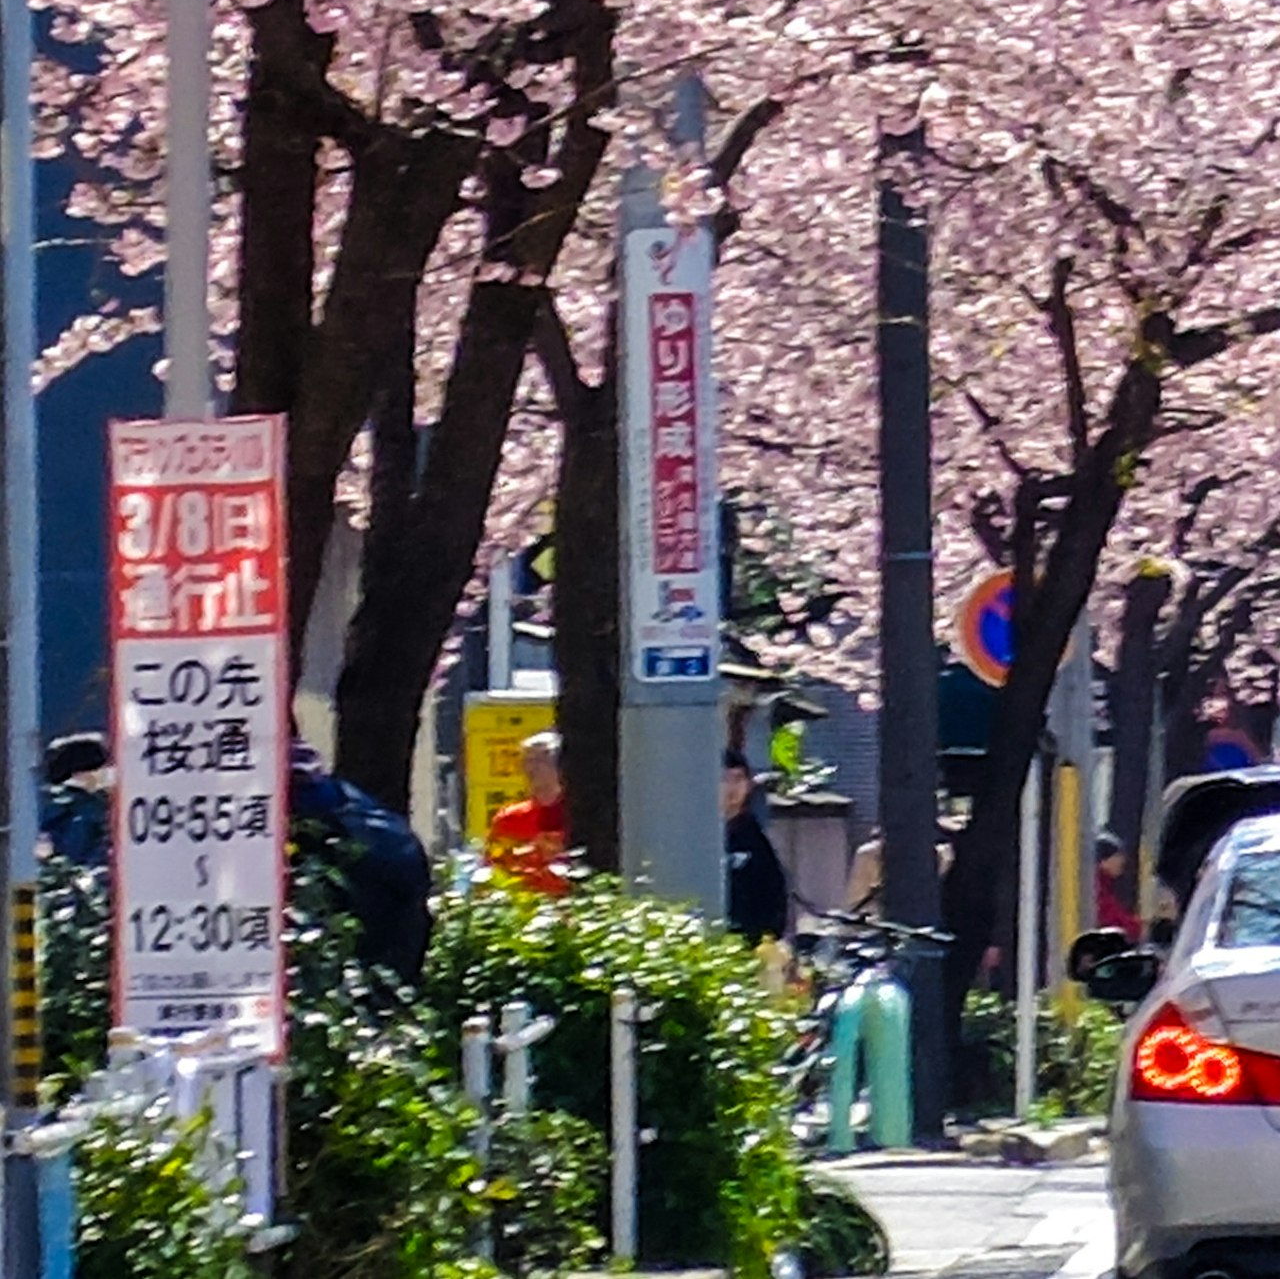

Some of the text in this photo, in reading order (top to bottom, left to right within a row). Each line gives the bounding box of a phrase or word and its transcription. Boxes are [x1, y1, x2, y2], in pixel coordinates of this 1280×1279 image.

[118, 559, 276, 632] 通行止
[130, 655, 263, 710] この先
[140, 717, 257, 777] 桜通
[128, 794, 273, 845] 09:55頃
[129, 903, 273, 953] 12:30頃
